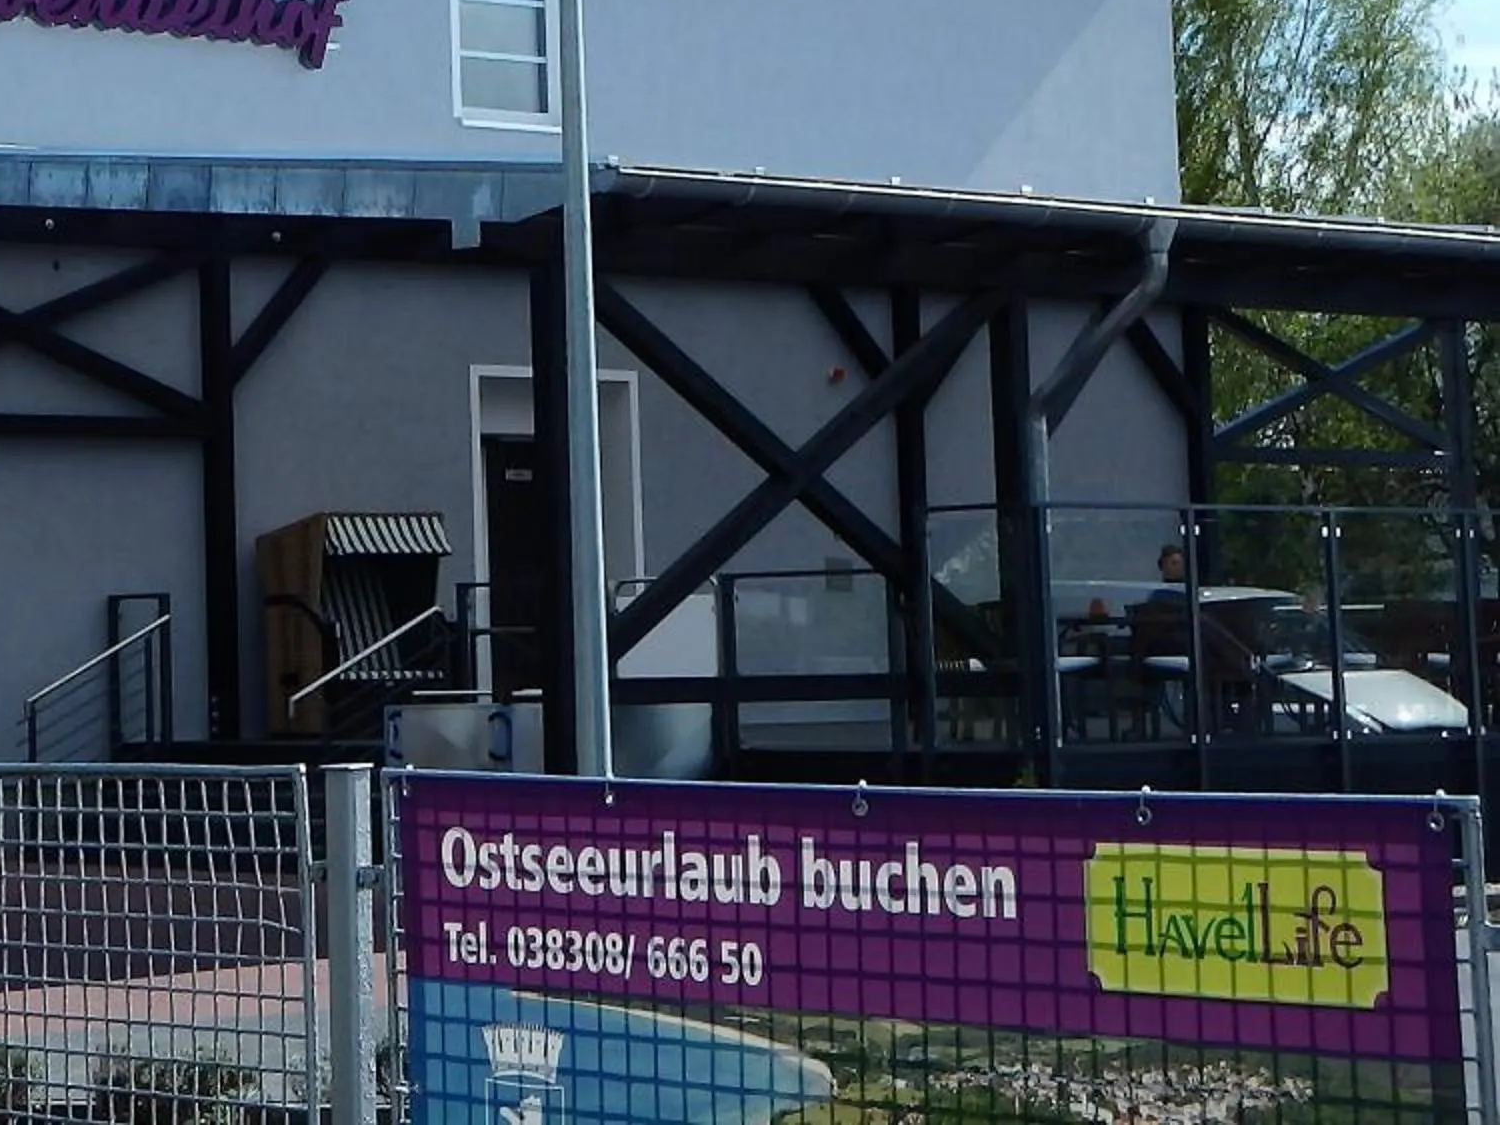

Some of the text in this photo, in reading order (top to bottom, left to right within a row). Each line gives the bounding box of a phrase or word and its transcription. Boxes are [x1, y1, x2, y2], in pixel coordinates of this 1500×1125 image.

[440, 825, 1017, 920] Ostseeurlaub buchen
[443, 921, 764, 986] Tel. 038308/ 666 50
